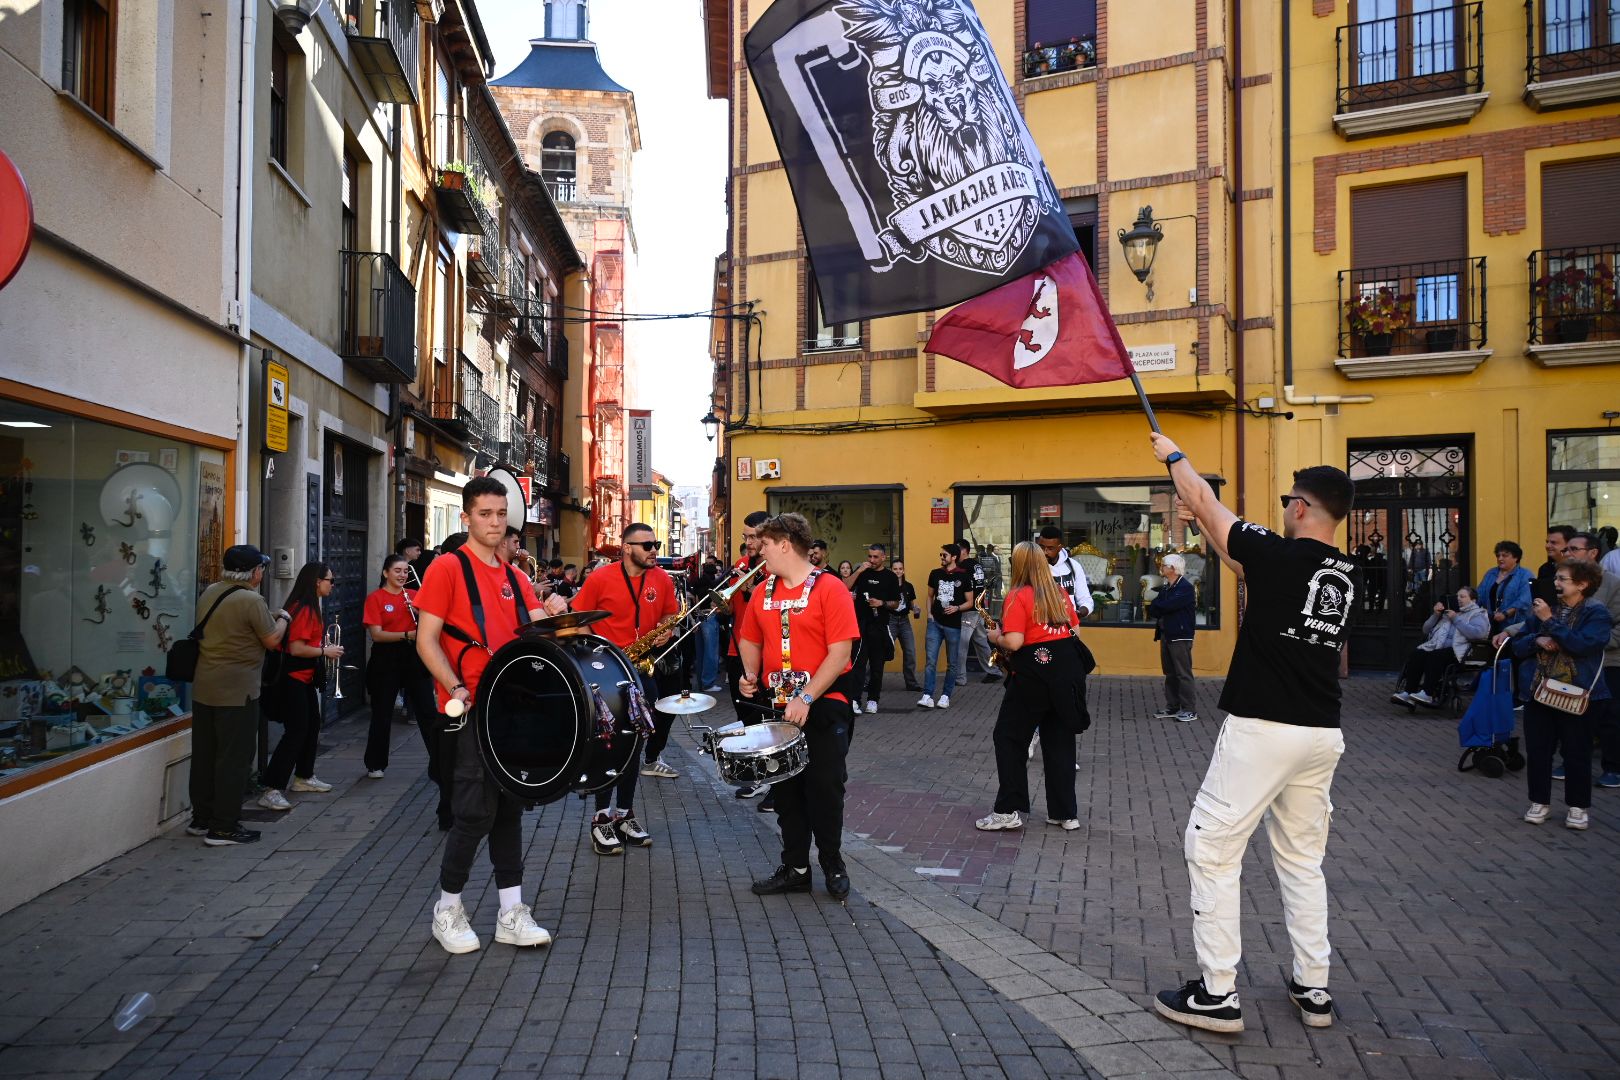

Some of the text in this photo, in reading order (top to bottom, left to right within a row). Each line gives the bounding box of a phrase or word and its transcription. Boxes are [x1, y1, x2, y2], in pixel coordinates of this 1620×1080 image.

[1389, 463, 1398, 478] 1
[1333, 559, 1355, 573] VINO
[1304, 617, 1341, 635] VERITAS
